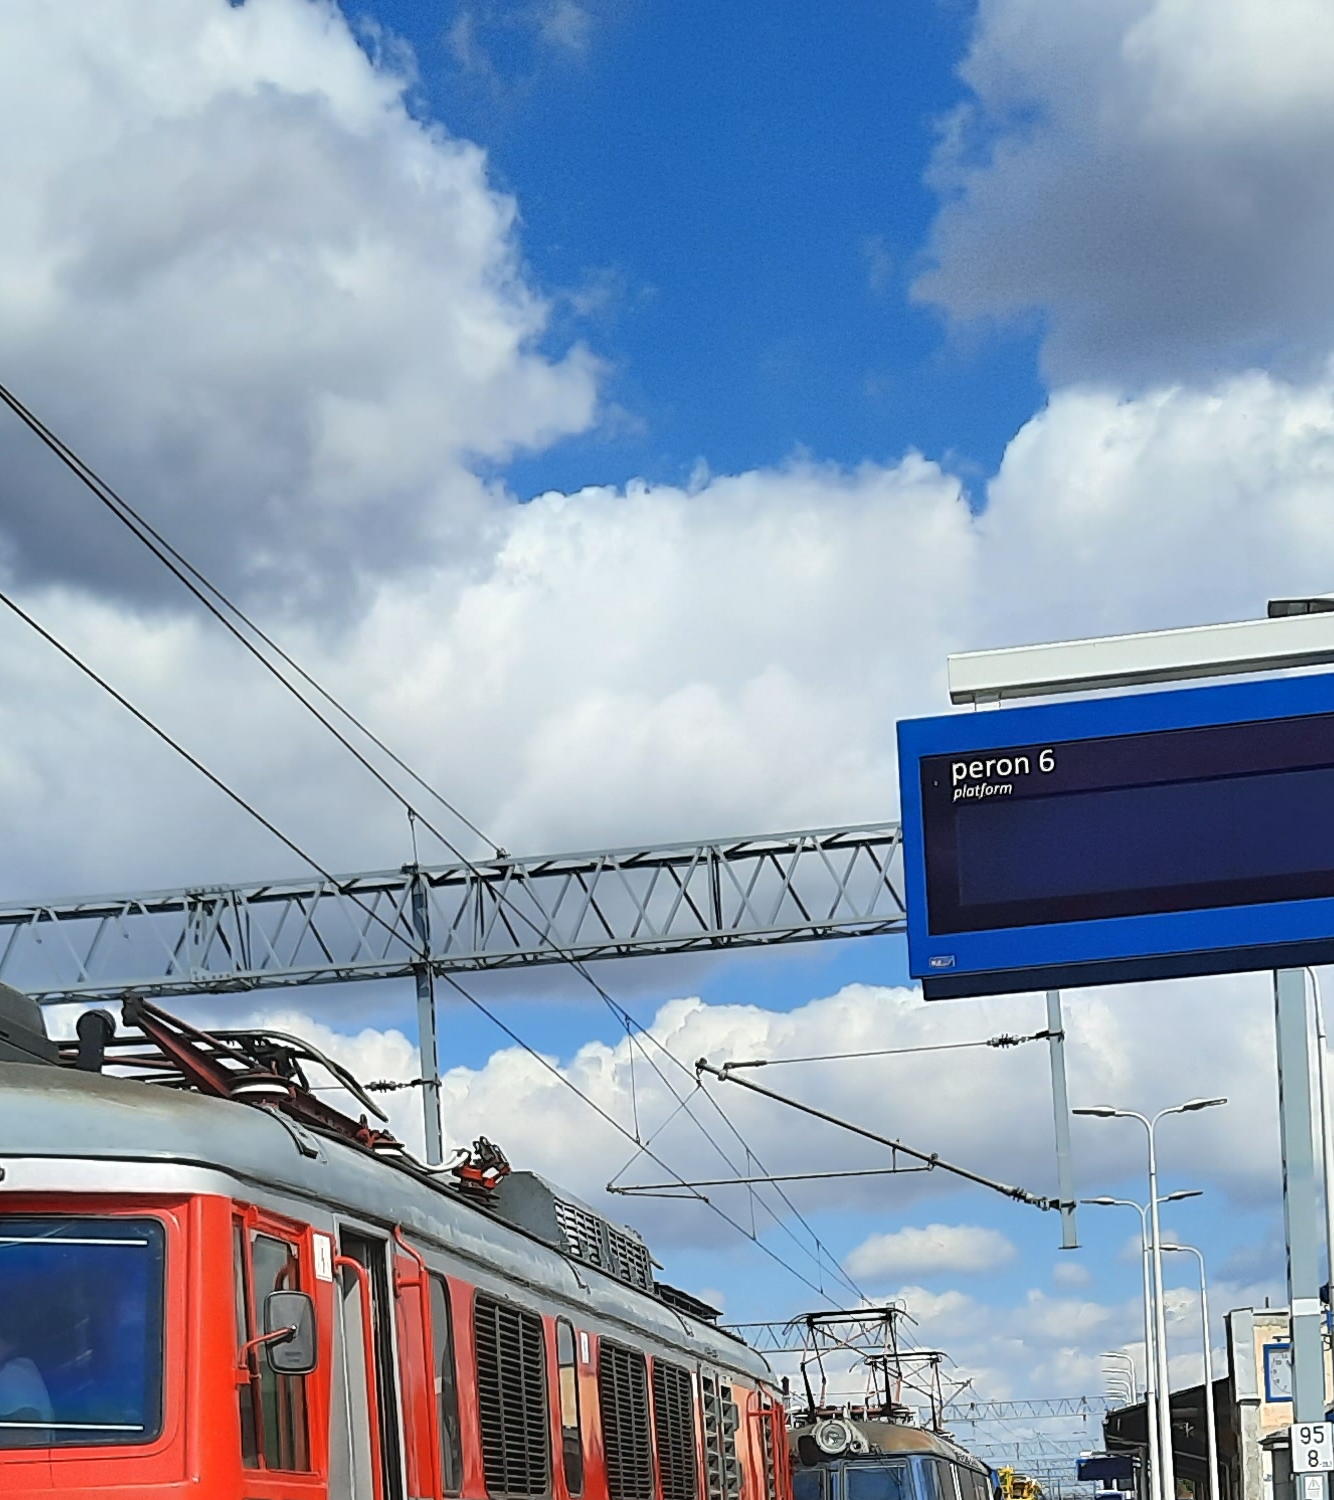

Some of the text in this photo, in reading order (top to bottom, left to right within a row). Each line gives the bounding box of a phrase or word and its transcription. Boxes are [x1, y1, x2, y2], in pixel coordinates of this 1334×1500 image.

[952, 748, 1055, 787] peron 6
[952, 782, 1013, 803] platform
[1299, 1425, 1325, 1445] 95
[1307, 1449, 1319, 1468] 8
